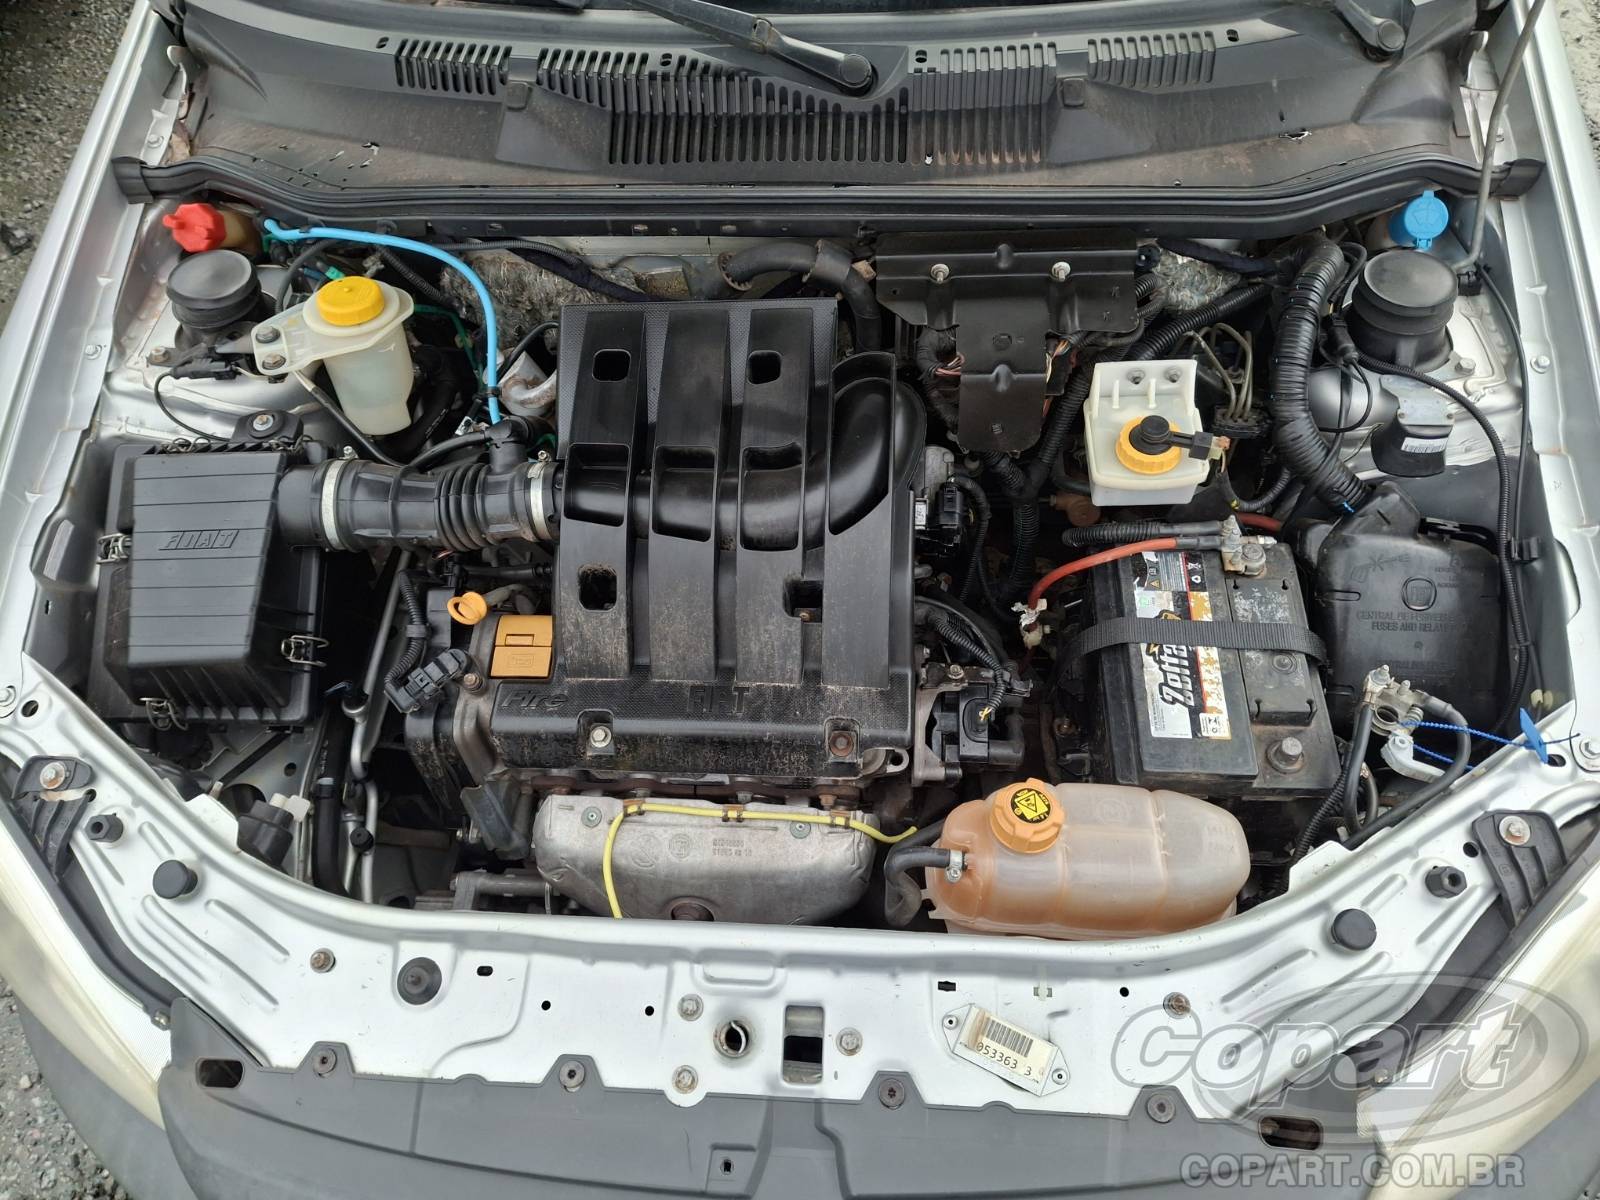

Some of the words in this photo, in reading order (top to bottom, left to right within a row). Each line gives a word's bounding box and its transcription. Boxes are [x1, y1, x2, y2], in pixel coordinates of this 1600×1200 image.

[160, 531, 238, 550] FIAT
[1371, 621, 1399, 632] FUSES
[501, 690, 569, 709] Fire
[976, 1041, 1018, 1070] 053363
[1024, 1065, 1032, 1076] 3
